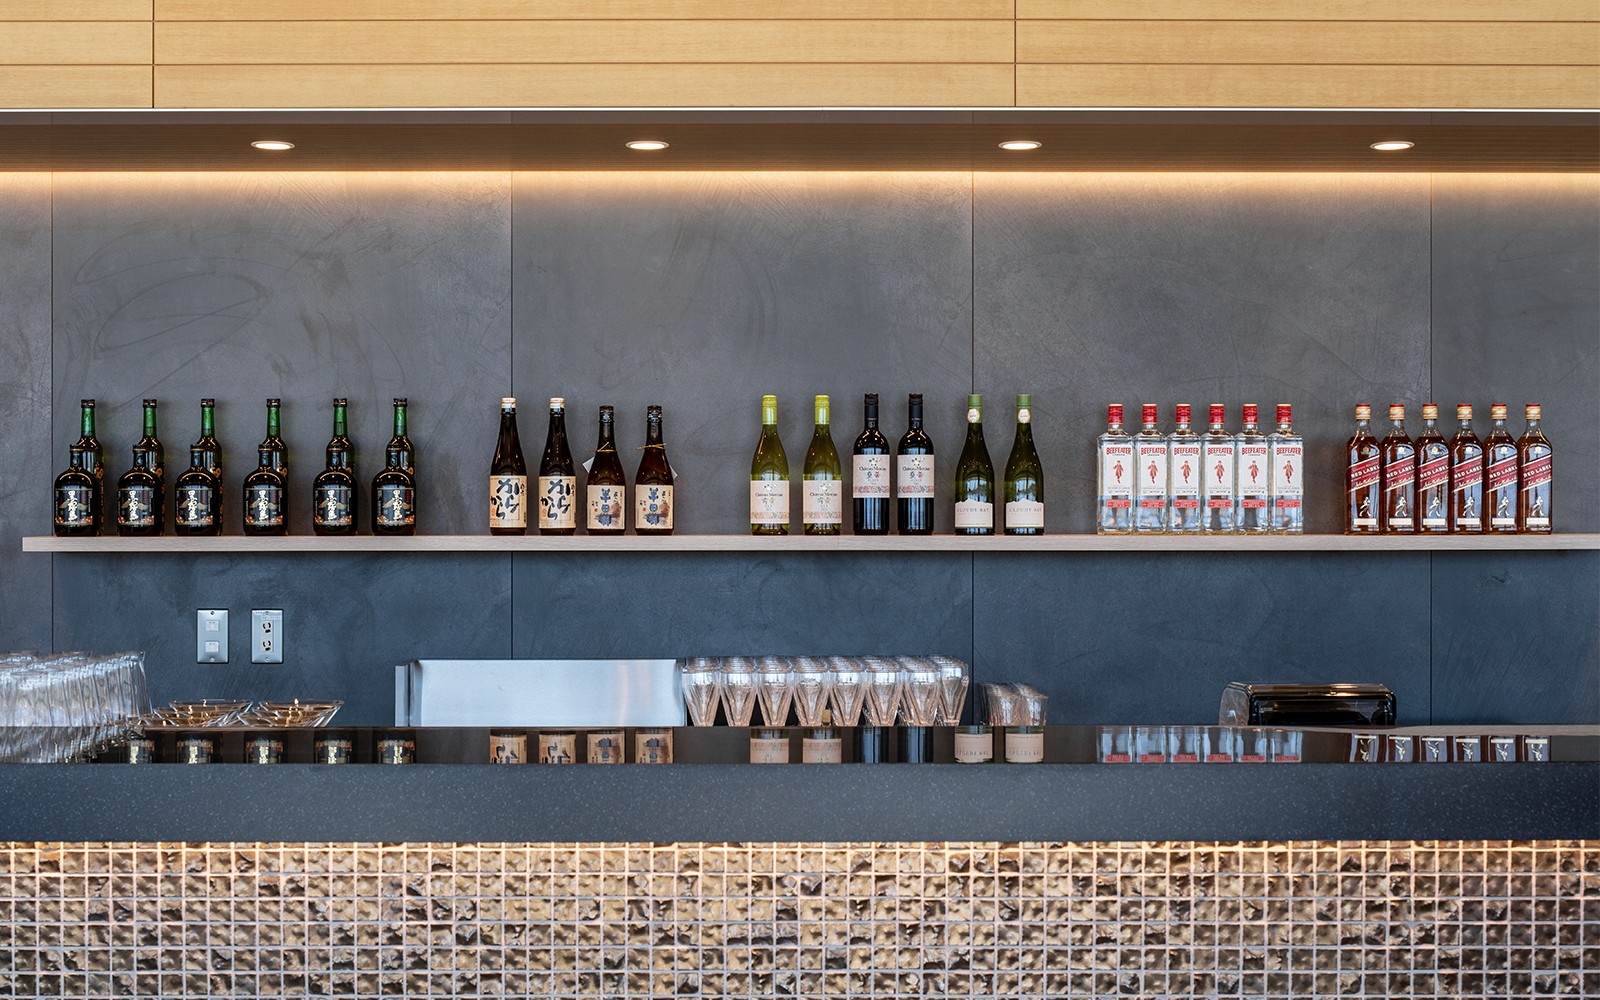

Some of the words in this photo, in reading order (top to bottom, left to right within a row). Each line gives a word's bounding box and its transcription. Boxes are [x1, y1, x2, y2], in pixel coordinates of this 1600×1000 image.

[1106, 447, 1131, 455] BEEFEATER
[1141, 447, 1166, 455] BEEFEATER
[1174, 447, 1199, 455] BEEFEATER
[1207, 447, 1232, 455] BEEFEATER
[1241, 447, 1266, 455] BEEFEATER
[1276, 447, 1301, 455] BEEFEATER
[1351, 470, 1362, 478] RED
[1363, 465, 1380, 475] LABEL
[1386, 470, 1398, 478] RED
[1398, 465, 1415, 475] LABEL
[1420, 470, 1431, 478] RED
[1432, 465, 1449, 475] LABEL
[1454, 471, 1465, 479] RED
[1466, 465, 1482, 475] LABEL
[1489, 471, 1500, 479] RED
[1501, 465, 1517, 475] LABEL
[1523, 470, 1534, 478] RED
[1535, 464, 1552, 474] LABEL
